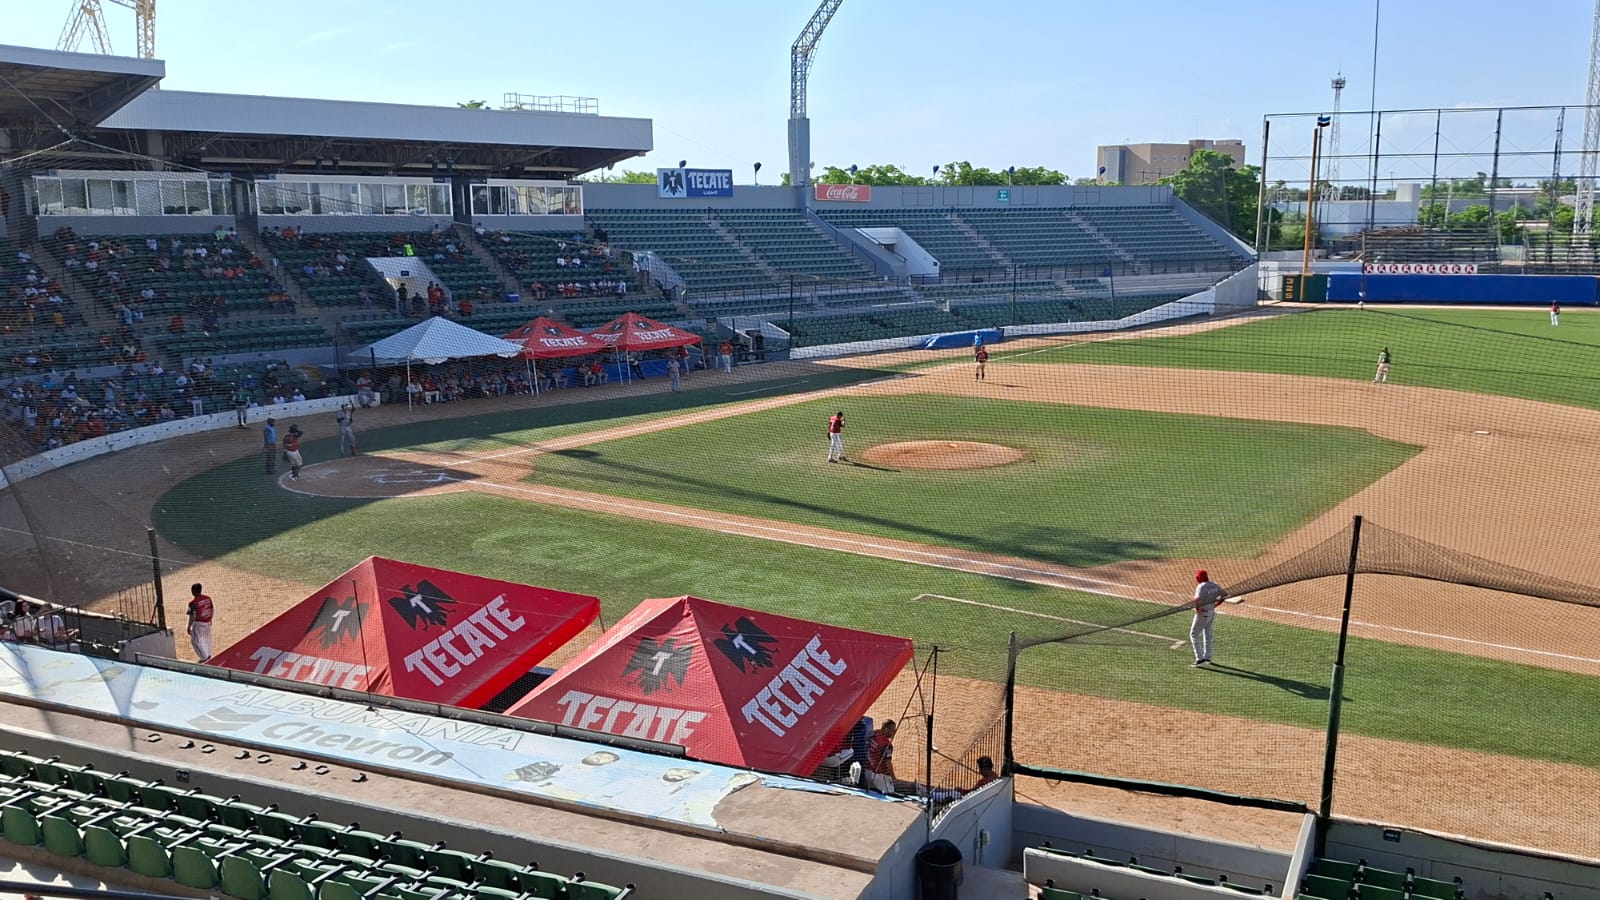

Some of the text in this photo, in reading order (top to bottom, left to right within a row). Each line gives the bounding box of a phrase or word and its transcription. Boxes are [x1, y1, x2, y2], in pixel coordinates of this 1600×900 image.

[688, 171, 730, 189] TECATE
[826, 185, 858, 200] Coca-Cola
[633, 328, 675, 341] TECATE
[403, 594, 526, 687] TECATE
[741, 633, 848, 737] TECATE
[208, 689, 525, 751] ALBUMANIA
[262, 721, 454, 766] Chevron
[557, 690, 707, 747] TECATE
